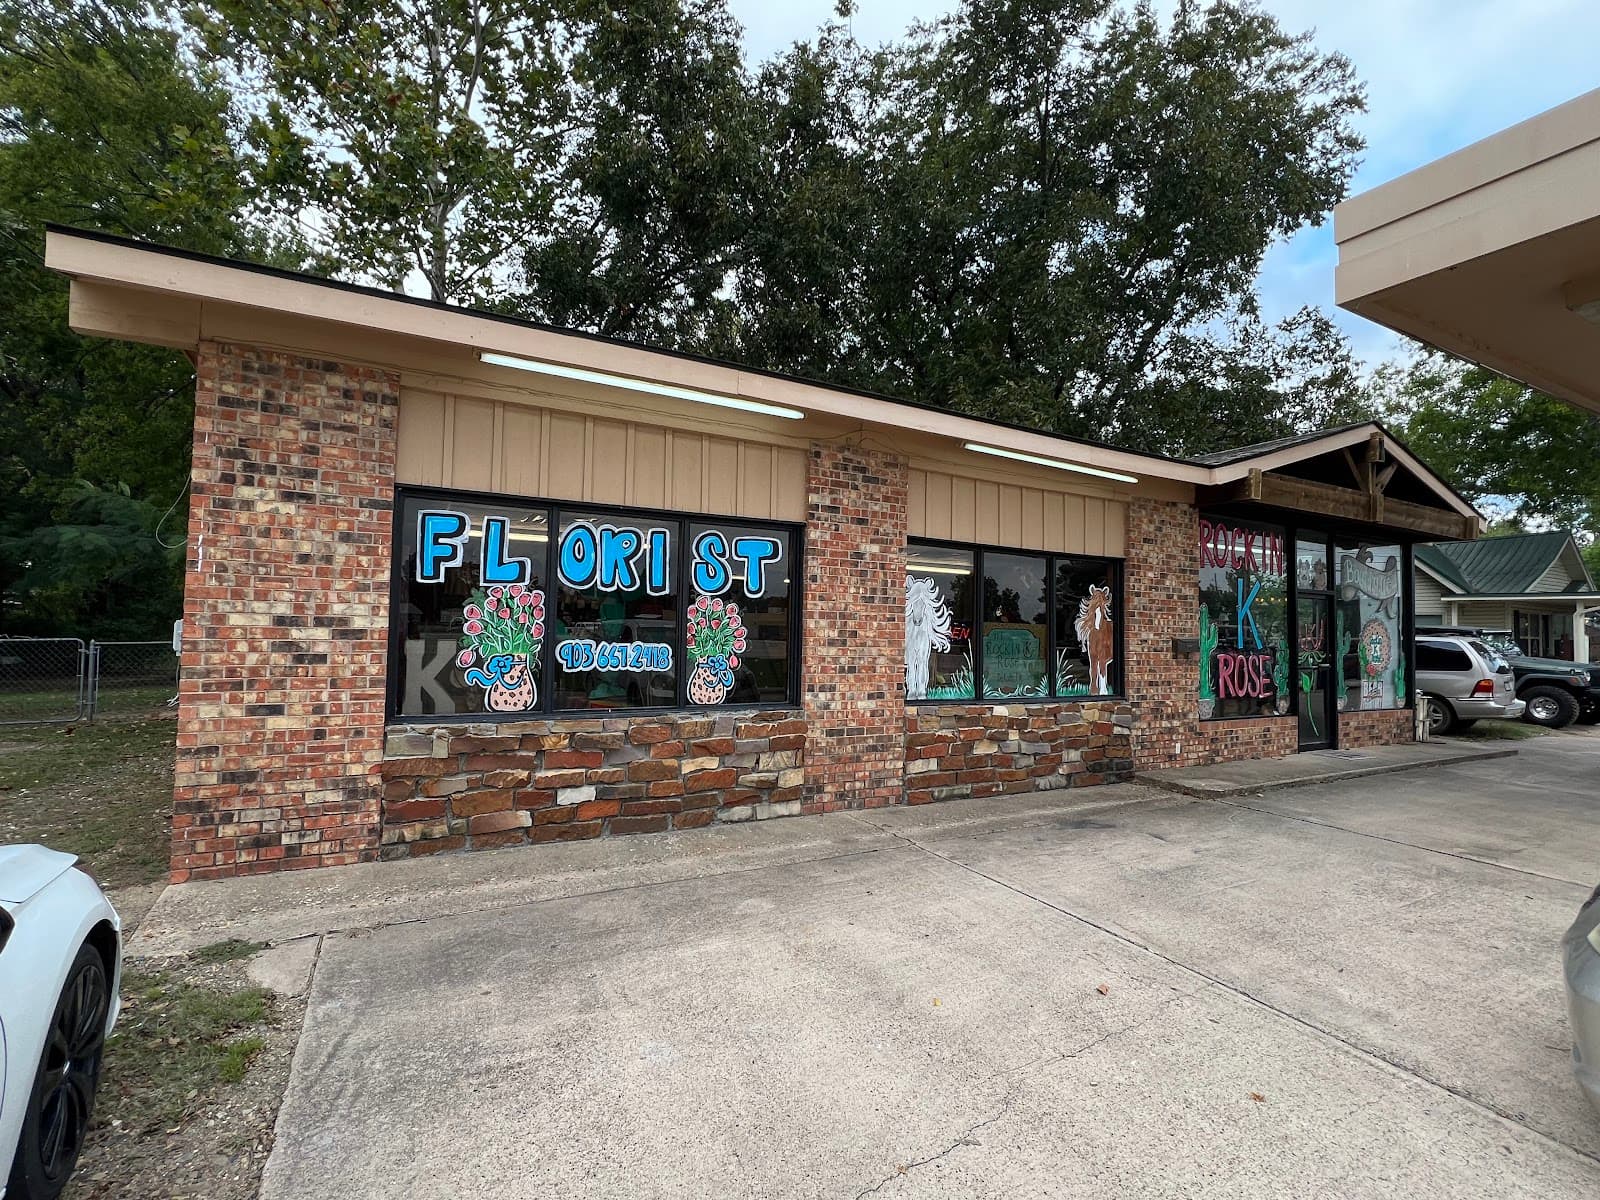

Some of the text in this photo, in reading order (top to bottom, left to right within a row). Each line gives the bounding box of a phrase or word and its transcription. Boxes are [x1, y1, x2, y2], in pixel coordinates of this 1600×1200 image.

[416, 509, 782, 598] FLORIST
[1199, 519, 1284, 576] ROCKIN
[1237, 577, 1264, 650] K
[404, 638, 457, 715] K
[556, 640, 595, 672] 903
[629, 642, 672, 671] 2418
[1216, 653, 1274, 699] ROSE
